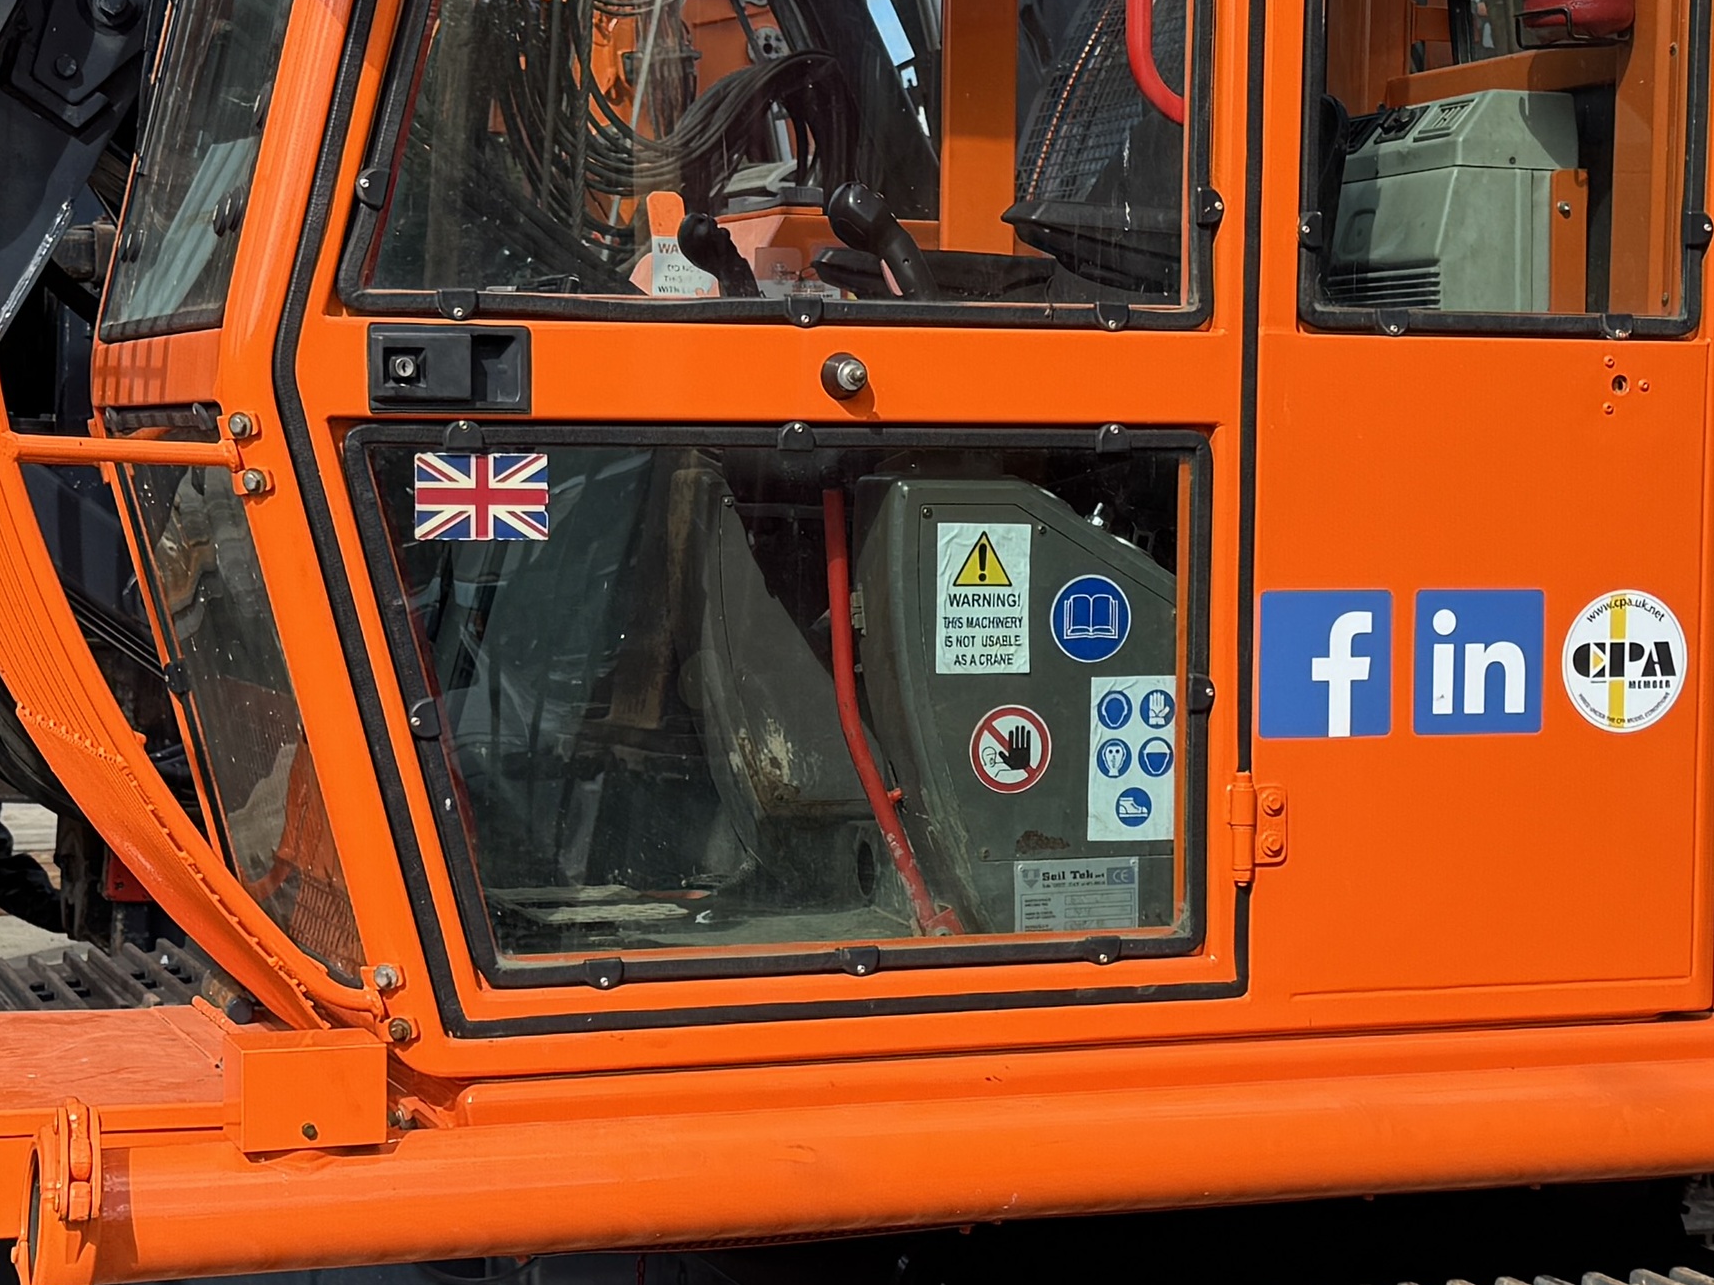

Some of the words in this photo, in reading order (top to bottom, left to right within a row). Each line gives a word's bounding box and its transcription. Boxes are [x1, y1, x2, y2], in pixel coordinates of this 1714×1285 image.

[948, 592, 1022, 608] WARNING!
[942, 616, 964, 629] THIS
[966, 616, 1023, 629] MACHINERY
[944, 635, 953, 648] IS
[955, 635, 976, 647] NOT
[981, 634, 1022, 647] USABLE
[953, 653, 968, 666] AS
[969, 653, 977, 666] A
[978, 653, 1014, 666] CRANE
[1432, 608, 1526, 715] in
[1573, 641, 1676, 678] CPA
[1628, 679, 1671, 690] MEMBER
[1112, 869, 1129, 883] CE
